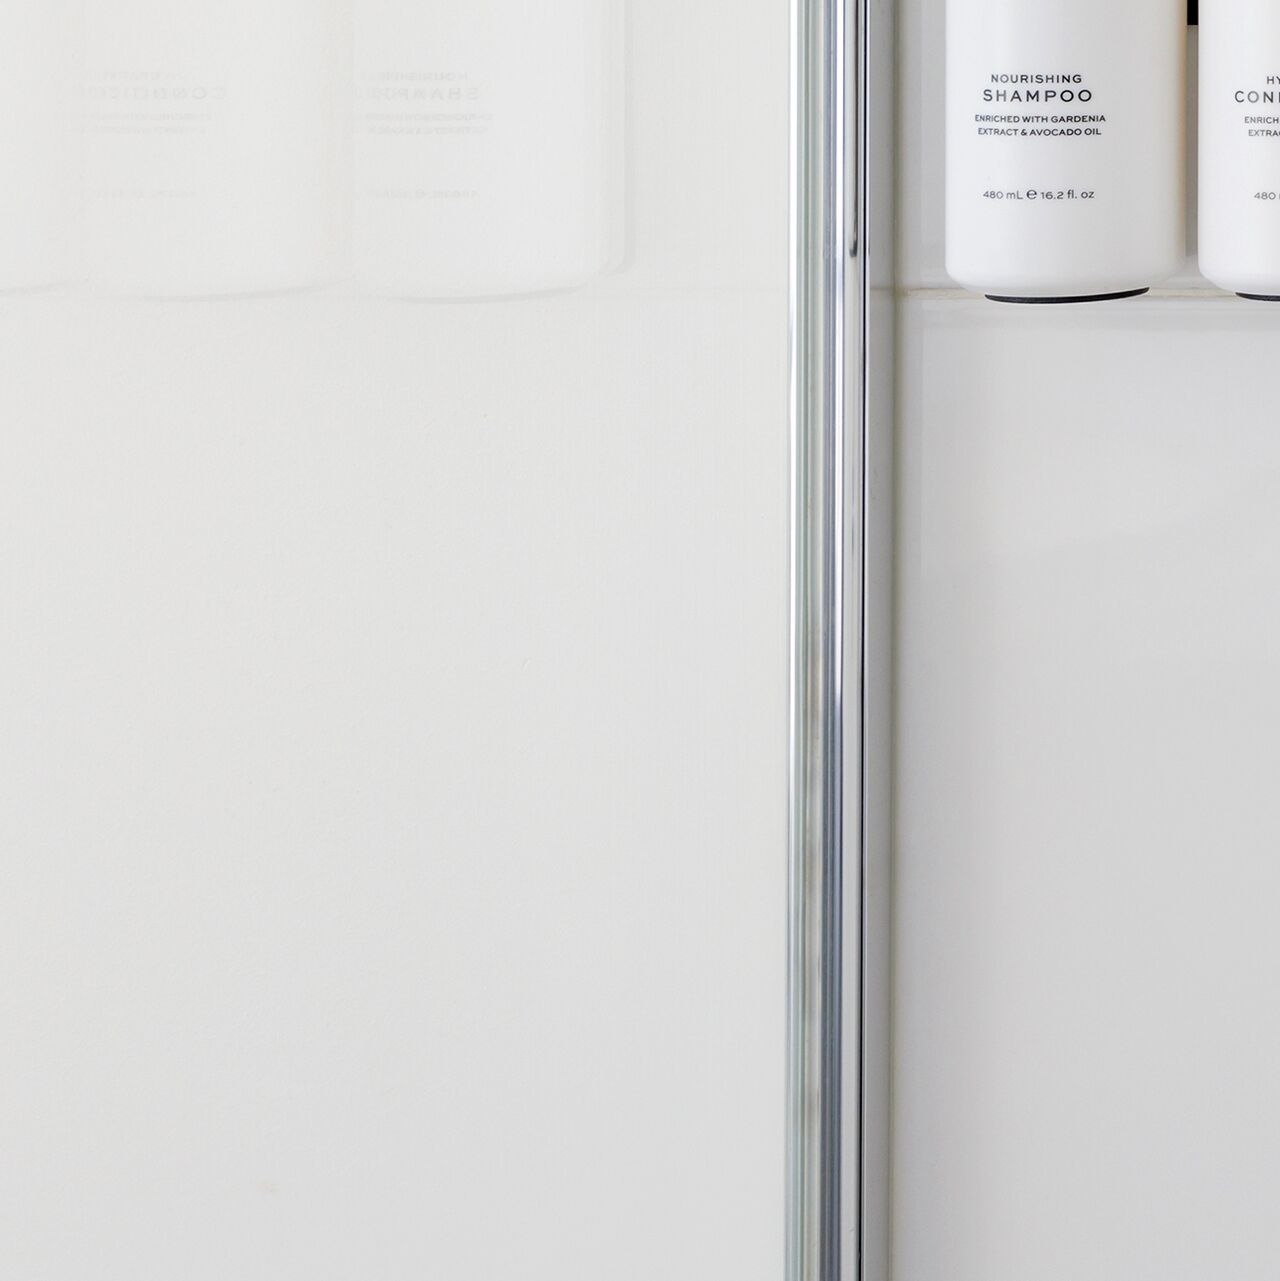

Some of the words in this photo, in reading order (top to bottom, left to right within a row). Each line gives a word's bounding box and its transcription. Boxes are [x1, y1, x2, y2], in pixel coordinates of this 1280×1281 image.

[990, 74, 1083, 84] NOURISHING
[983, 89, 1093, 102] SHAMPOO
[975, 114, 1020, 123] ENRICHED
[1022, 114, 1048, 123] WITH
[1050, 114, 1106, 123] GARDENIA
[978, 128, 1019, 136] EXTRACT
[1020, 128, 1027, 136] &
[1029, 128, 1082, 136] AVOCADO
[1084, 128, 1102, 136] OIL
[982, 191, 1004, 200] 480
[1006, 191, 1024, 200] mL
[1040, 191, 1064, 200] 16.2
[1081, 191, 1095, 199] oz
[1254, 192, 1276, 201] 480
